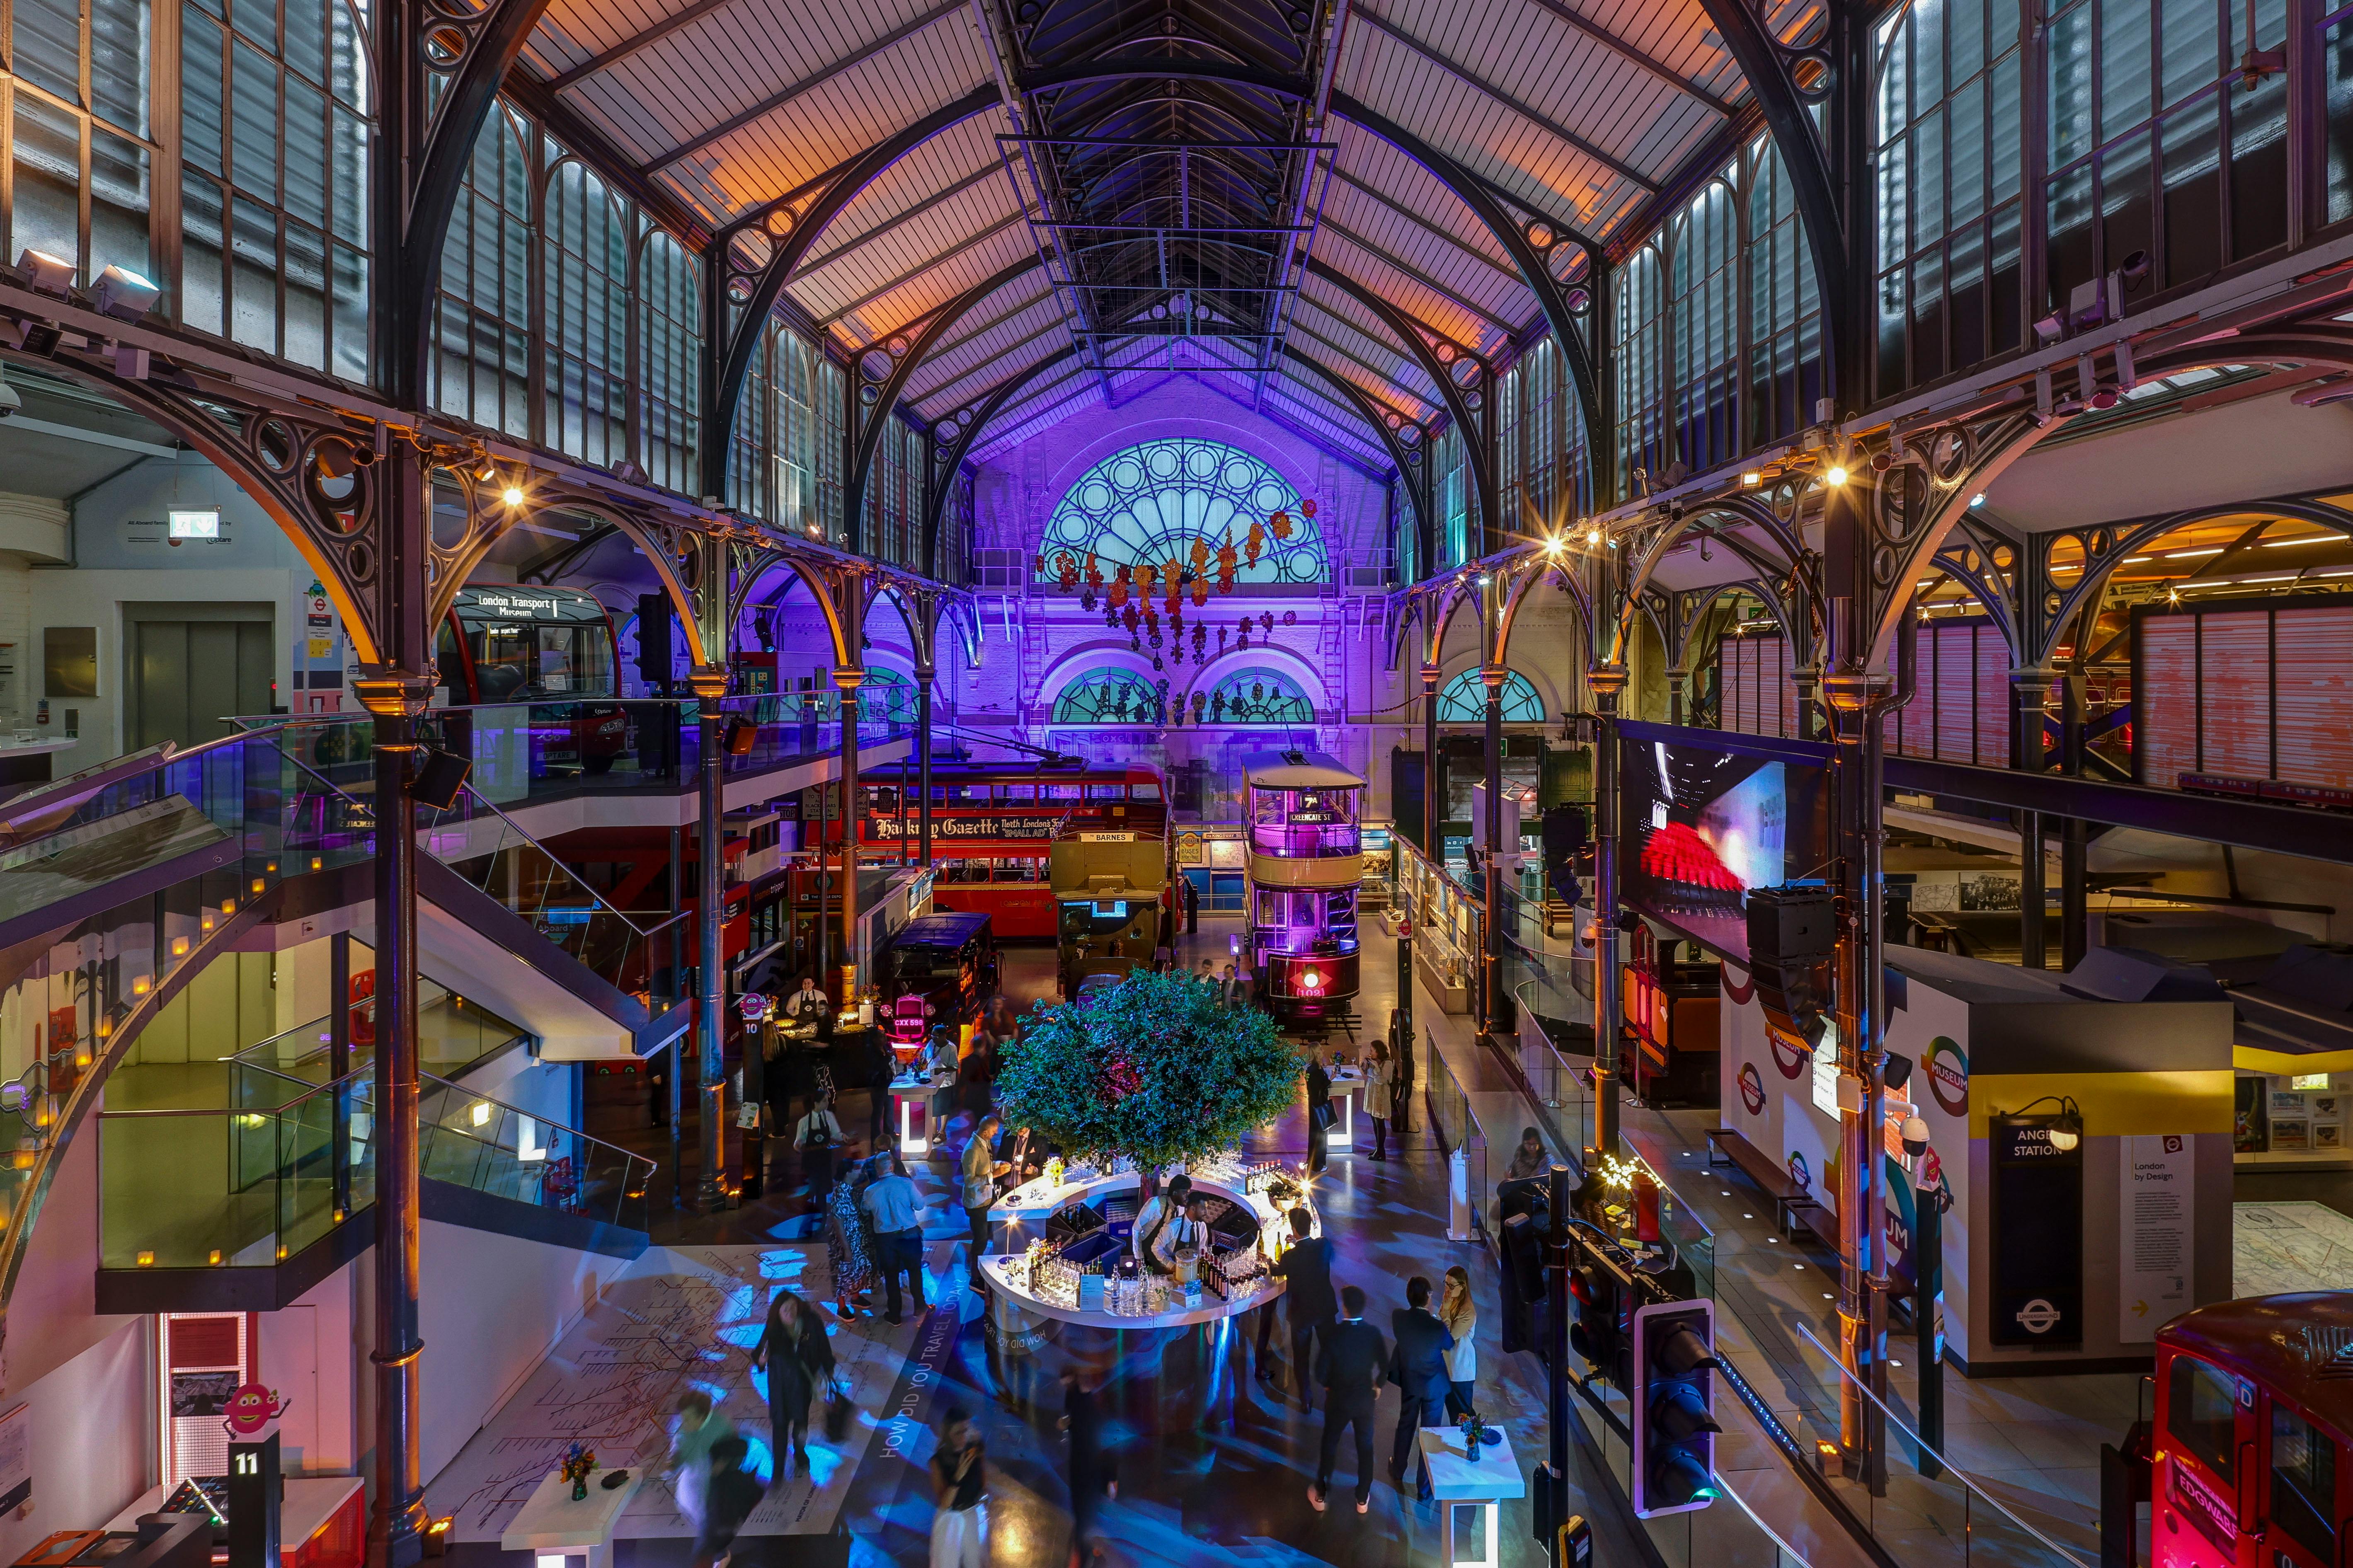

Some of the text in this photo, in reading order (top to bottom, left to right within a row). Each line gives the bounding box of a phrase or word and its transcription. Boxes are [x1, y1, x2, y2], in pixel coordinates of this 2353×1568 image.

[479, 595, 508, 606] London
[511, 596, 550, 610] Transport
[499, 607, 531, 617] Museum
[876, 818, 998, 839] Hacky Gazette
[1001, 819, 1020, 828] North
[1023, 818, 1050, 828] London's
[771, 881, 785, 894] tripper
[1405, 942, 1409, 950] 9
[745, 1024, 757, 1033] 10
[1773, 1029, 1800, 1054] MUSEUM
[1931, 1063, 1968, 1091] MUSEUM
[1742, 1079, 1761, 1098] MUSEUM
[2018, 1130, 2050, 1140] ANGE
[2014, 1146, 2062, 1156] STATION
[1792, 1163, 1807, 1179] MUSEUM
[1934, 1195, 1938, 1212] 1
[879, 1280, 967, 1458] HOW DID YOU TRAVEL TODAY?
[2241, 1388, 2252, 1407] D
[236, 1453, 258, 1474] 11
[2180, 1475, 2237, 1537] EDGWARE
